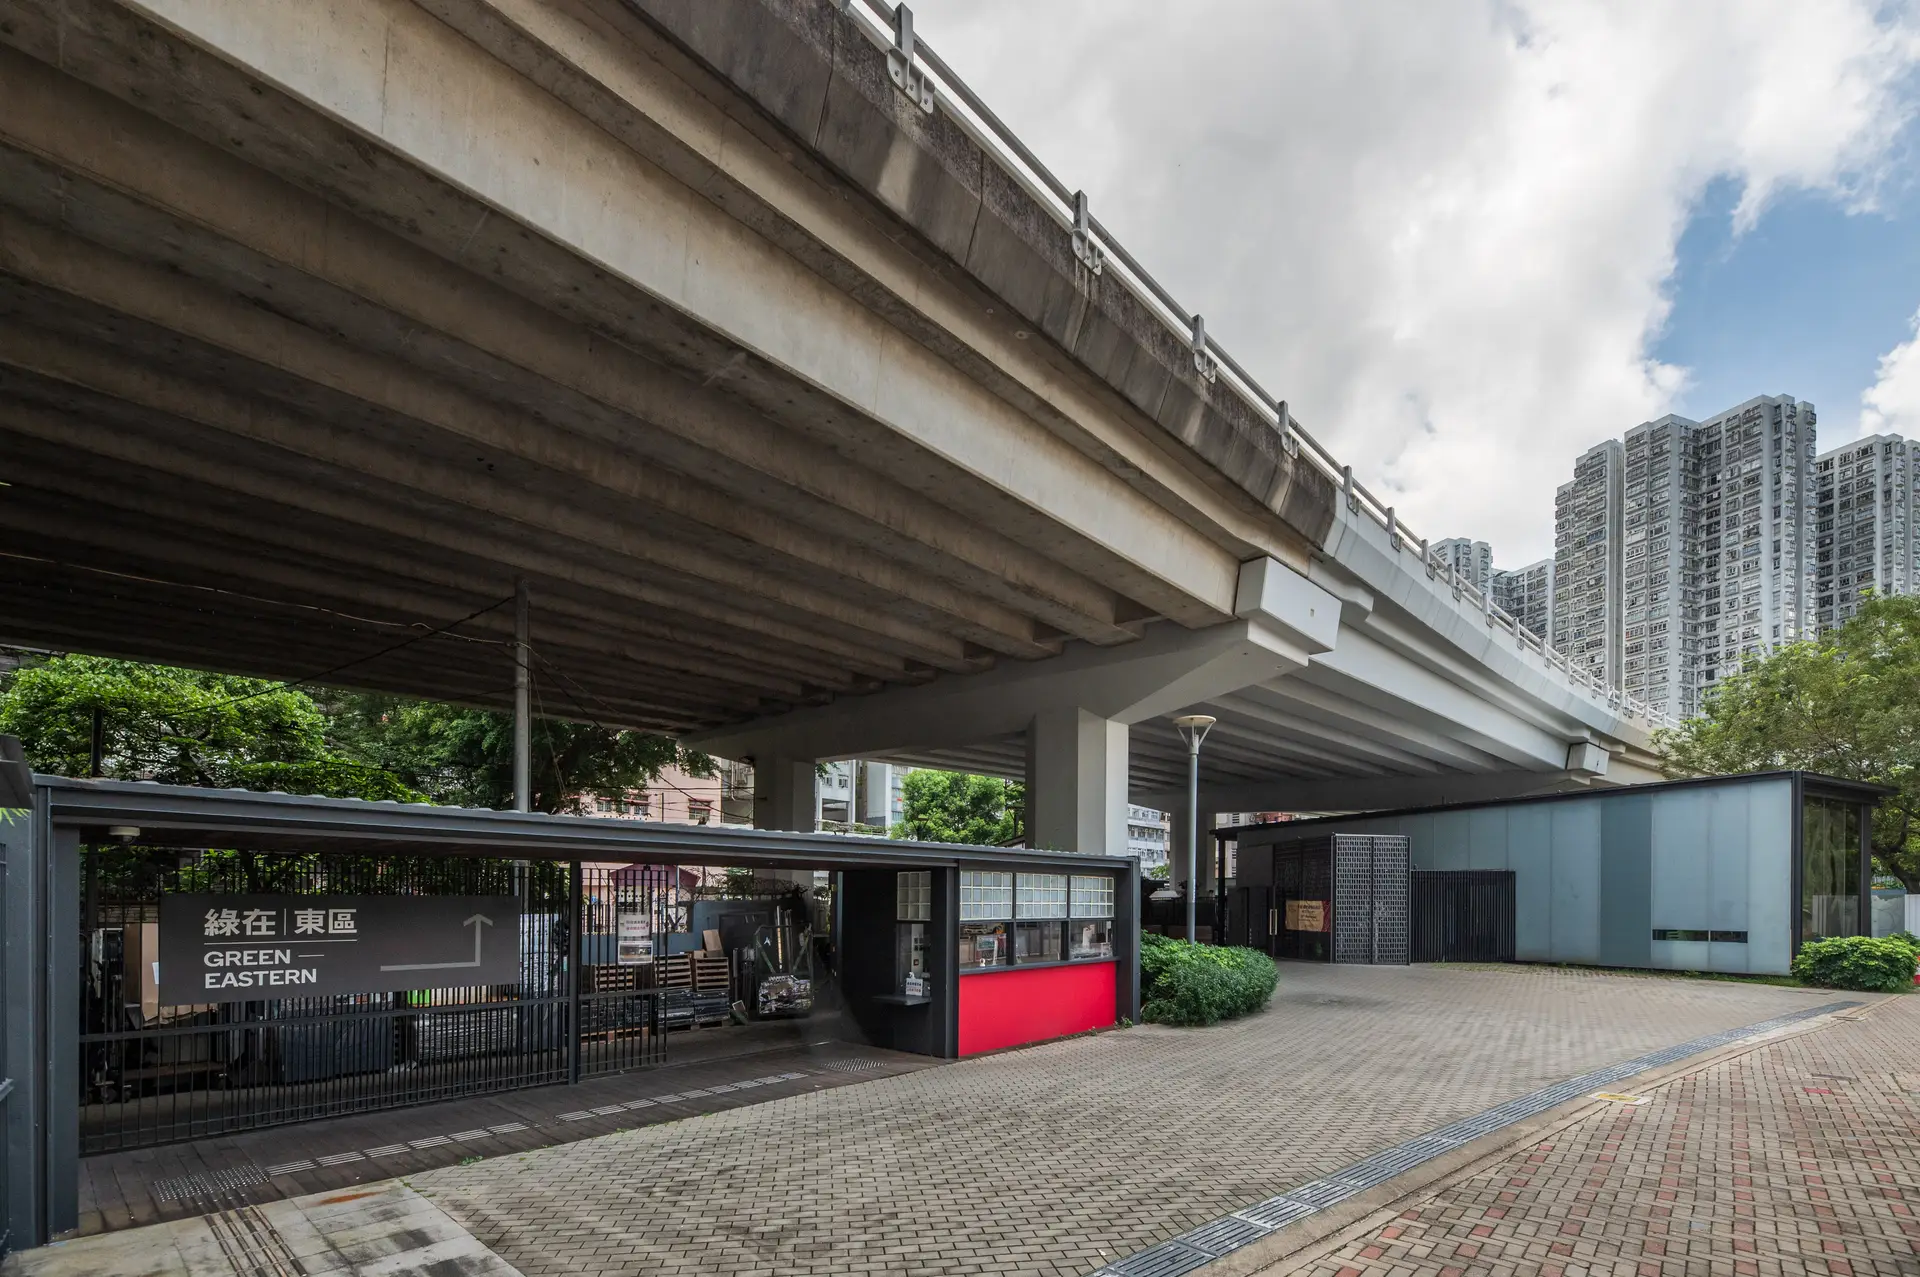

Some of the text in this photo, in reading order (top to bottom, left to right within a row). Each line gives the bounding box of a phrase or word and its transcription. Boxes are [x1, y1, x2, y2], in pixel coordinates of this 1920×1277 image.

[204, 908, 357, 936] 綠在 東區
[203, 949, 291, 967] GREEN
[205, 968, 317, 989] EASTERN
